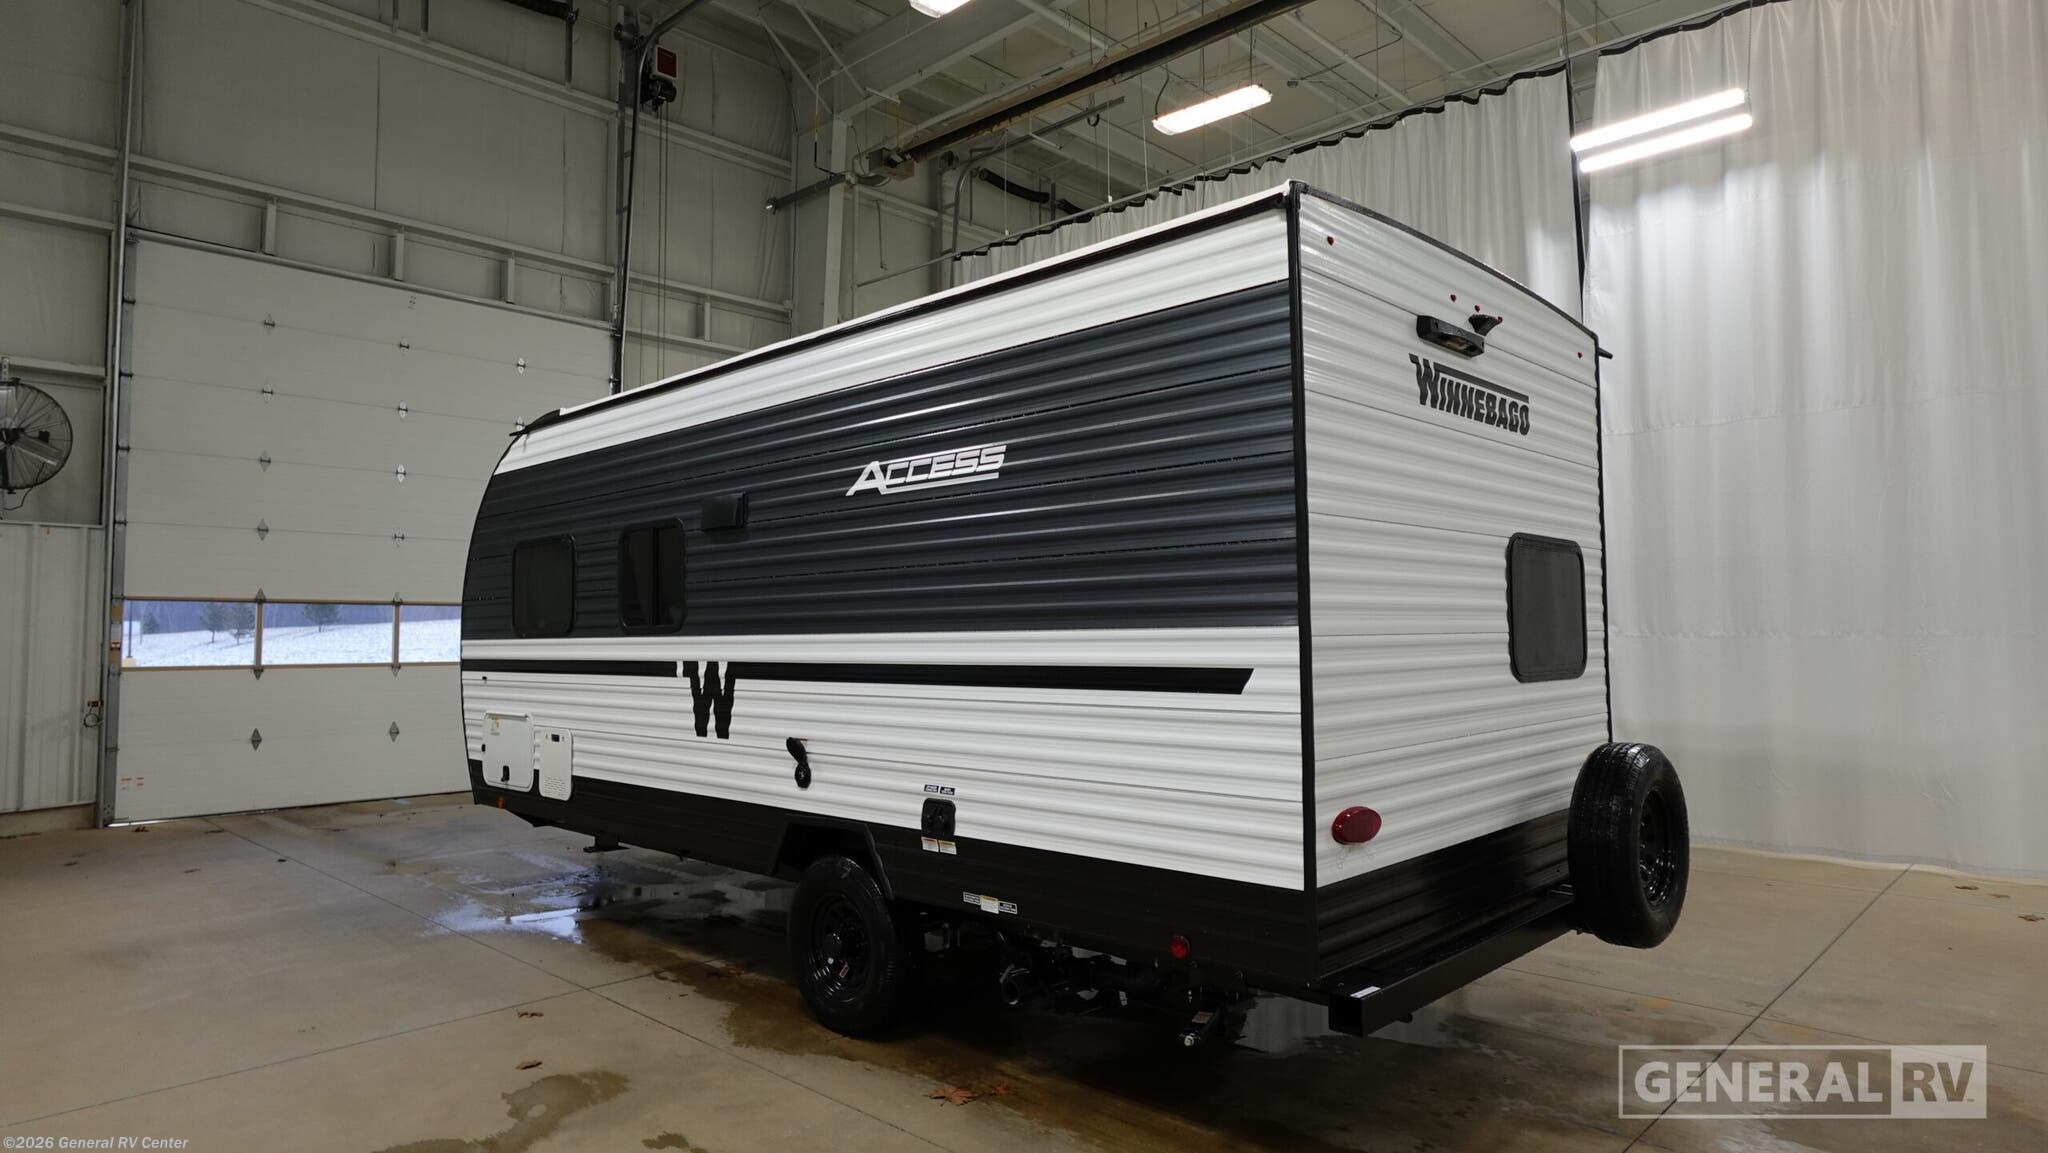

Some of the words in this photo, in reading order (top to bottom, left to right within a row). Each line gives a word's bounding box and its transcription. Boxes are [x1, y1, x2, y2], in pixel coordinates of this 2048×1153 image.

[1409, 353, 1530, 436] WINNEBAGO
[846, 444, 1007, 496] ACCESS
[682, 660, 737, 739] W
